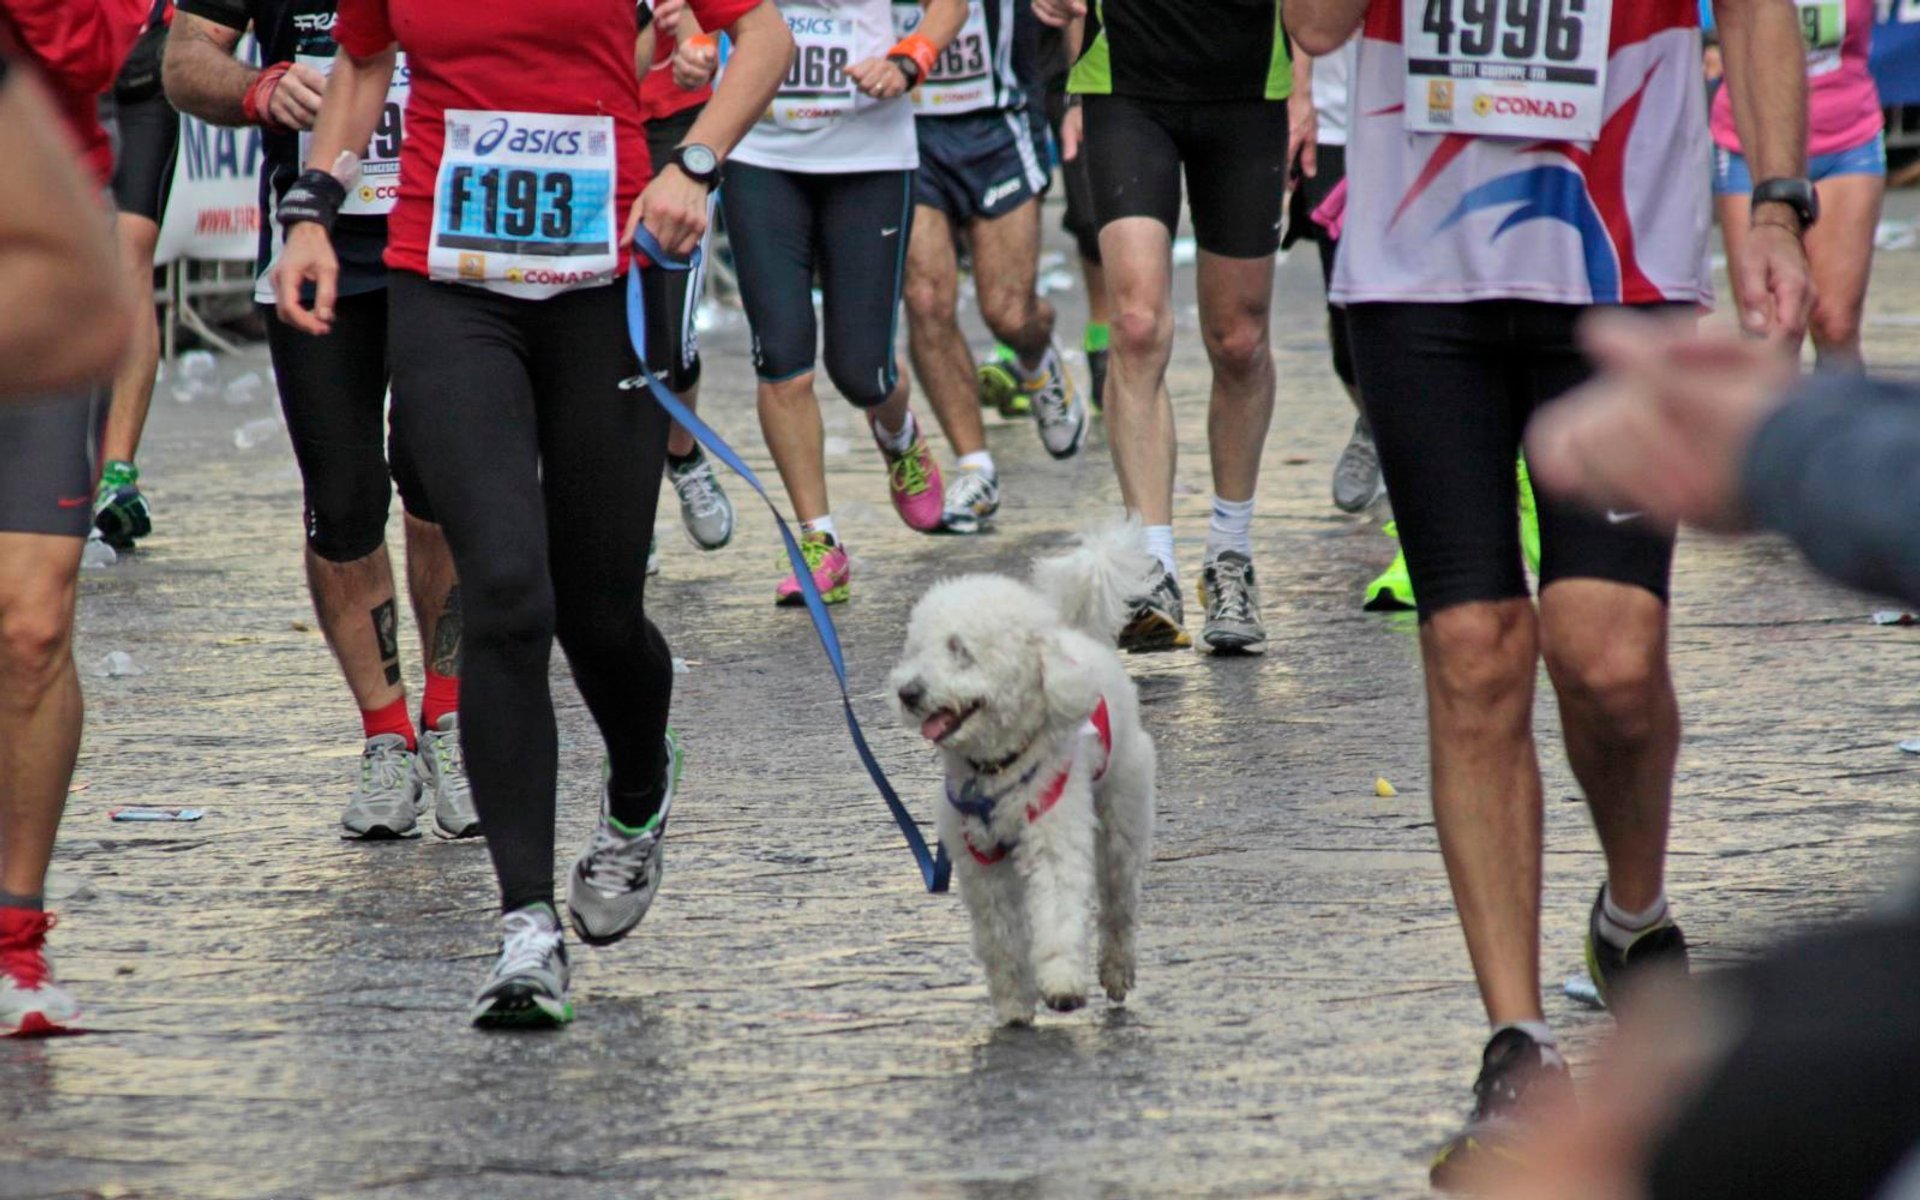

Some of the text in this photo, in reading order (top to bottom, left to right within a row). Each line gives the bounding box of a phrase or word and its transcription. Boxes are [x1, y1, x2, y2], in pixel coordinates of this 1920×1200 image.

[1423, 0, 1584, 61] 4996
[361, 102, 401, 158] 9
[1495, 96, 1576, 119] CONAD
[448, 166, 573, 238] F193
